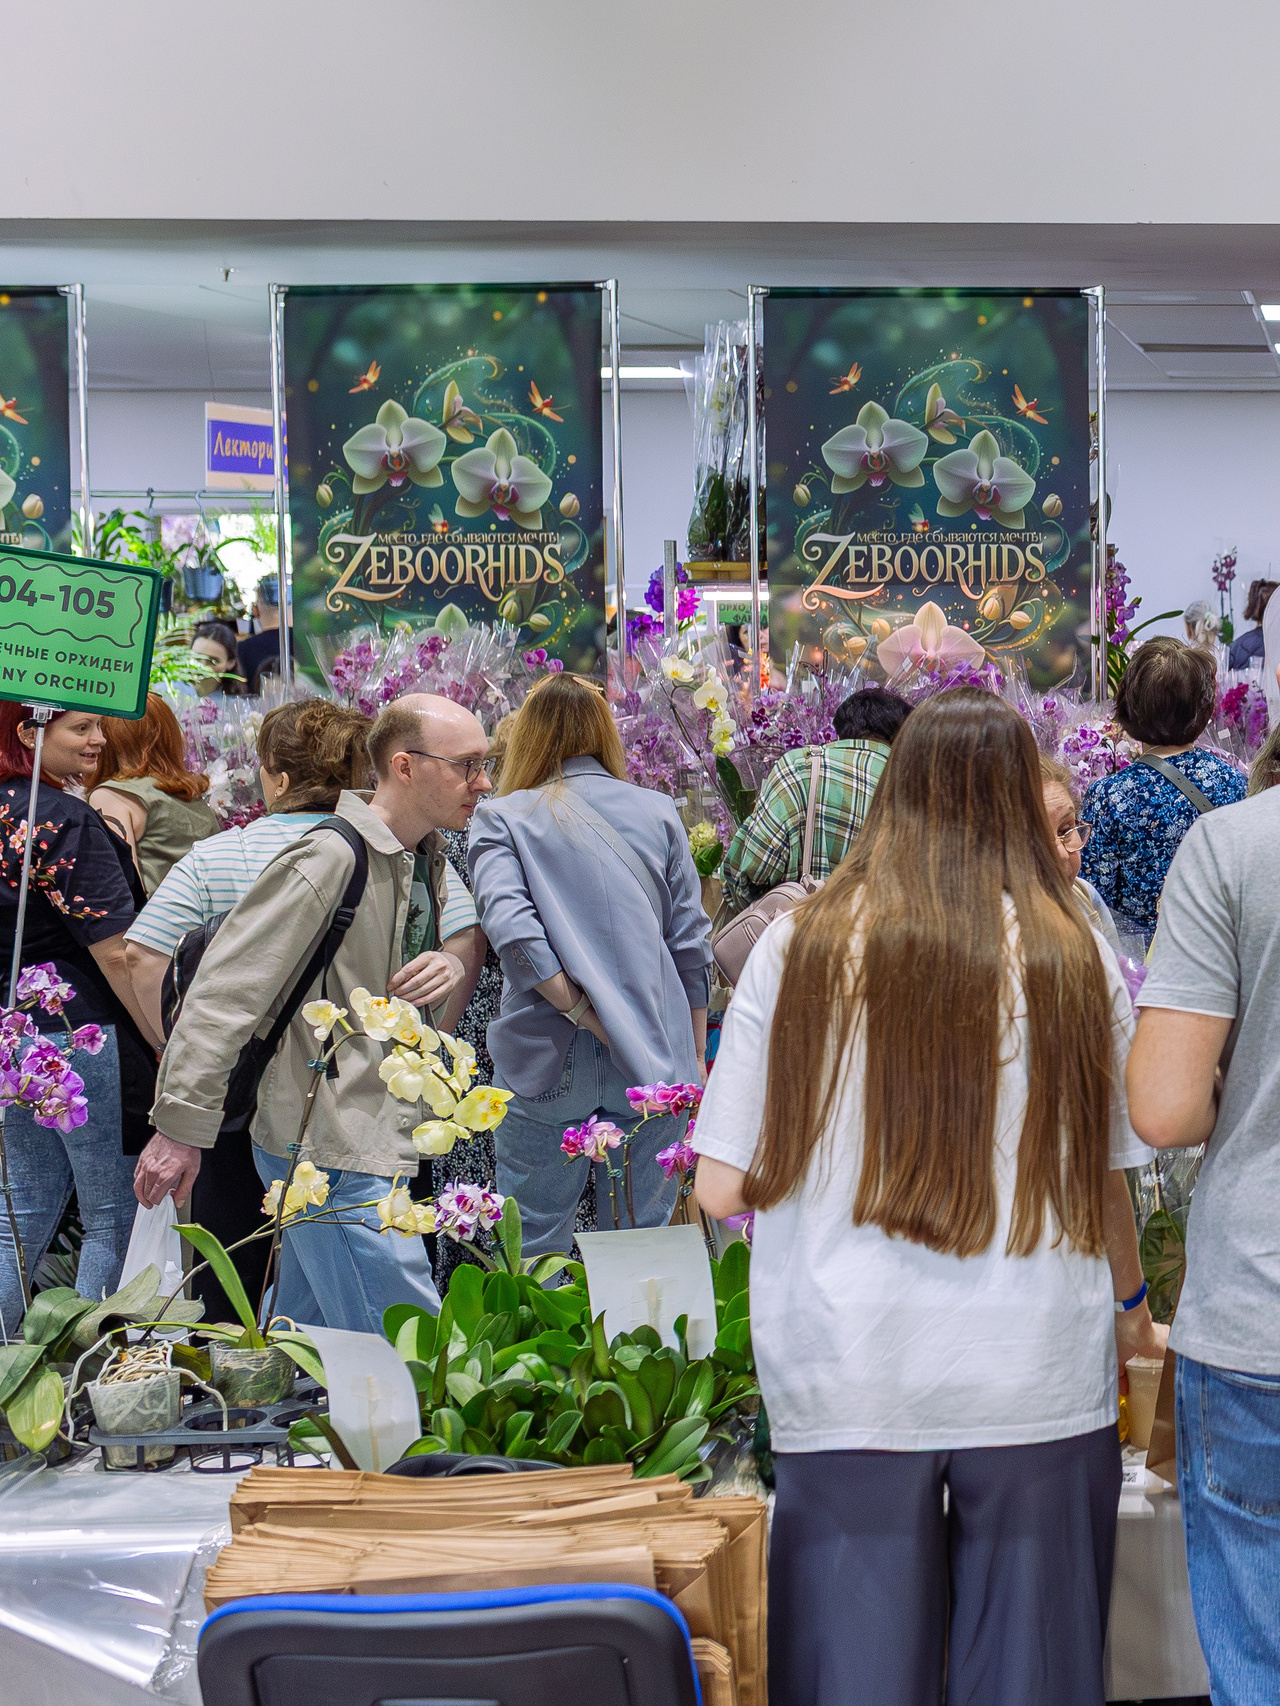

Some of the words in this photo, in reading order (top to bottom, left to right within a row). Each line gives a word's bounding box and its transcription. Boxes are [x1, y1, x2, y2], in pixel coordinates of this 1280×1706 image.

[213, 431, 274, 470] Лектори
[901, 532, 924, 545] где
[925, 528, 997, 543] сбываются
[999, 531, 1042, 543] мечты
[326, 532, 566, 613] ZEBOORHIDS
[802, 531, 1046, 610] ZEBOORHIDS
[0, 575, 116, 619] 04-105
[55, 650, 135, 674] ОРХИДЕИ
[34, 672, 116, 698] ORCHID)
